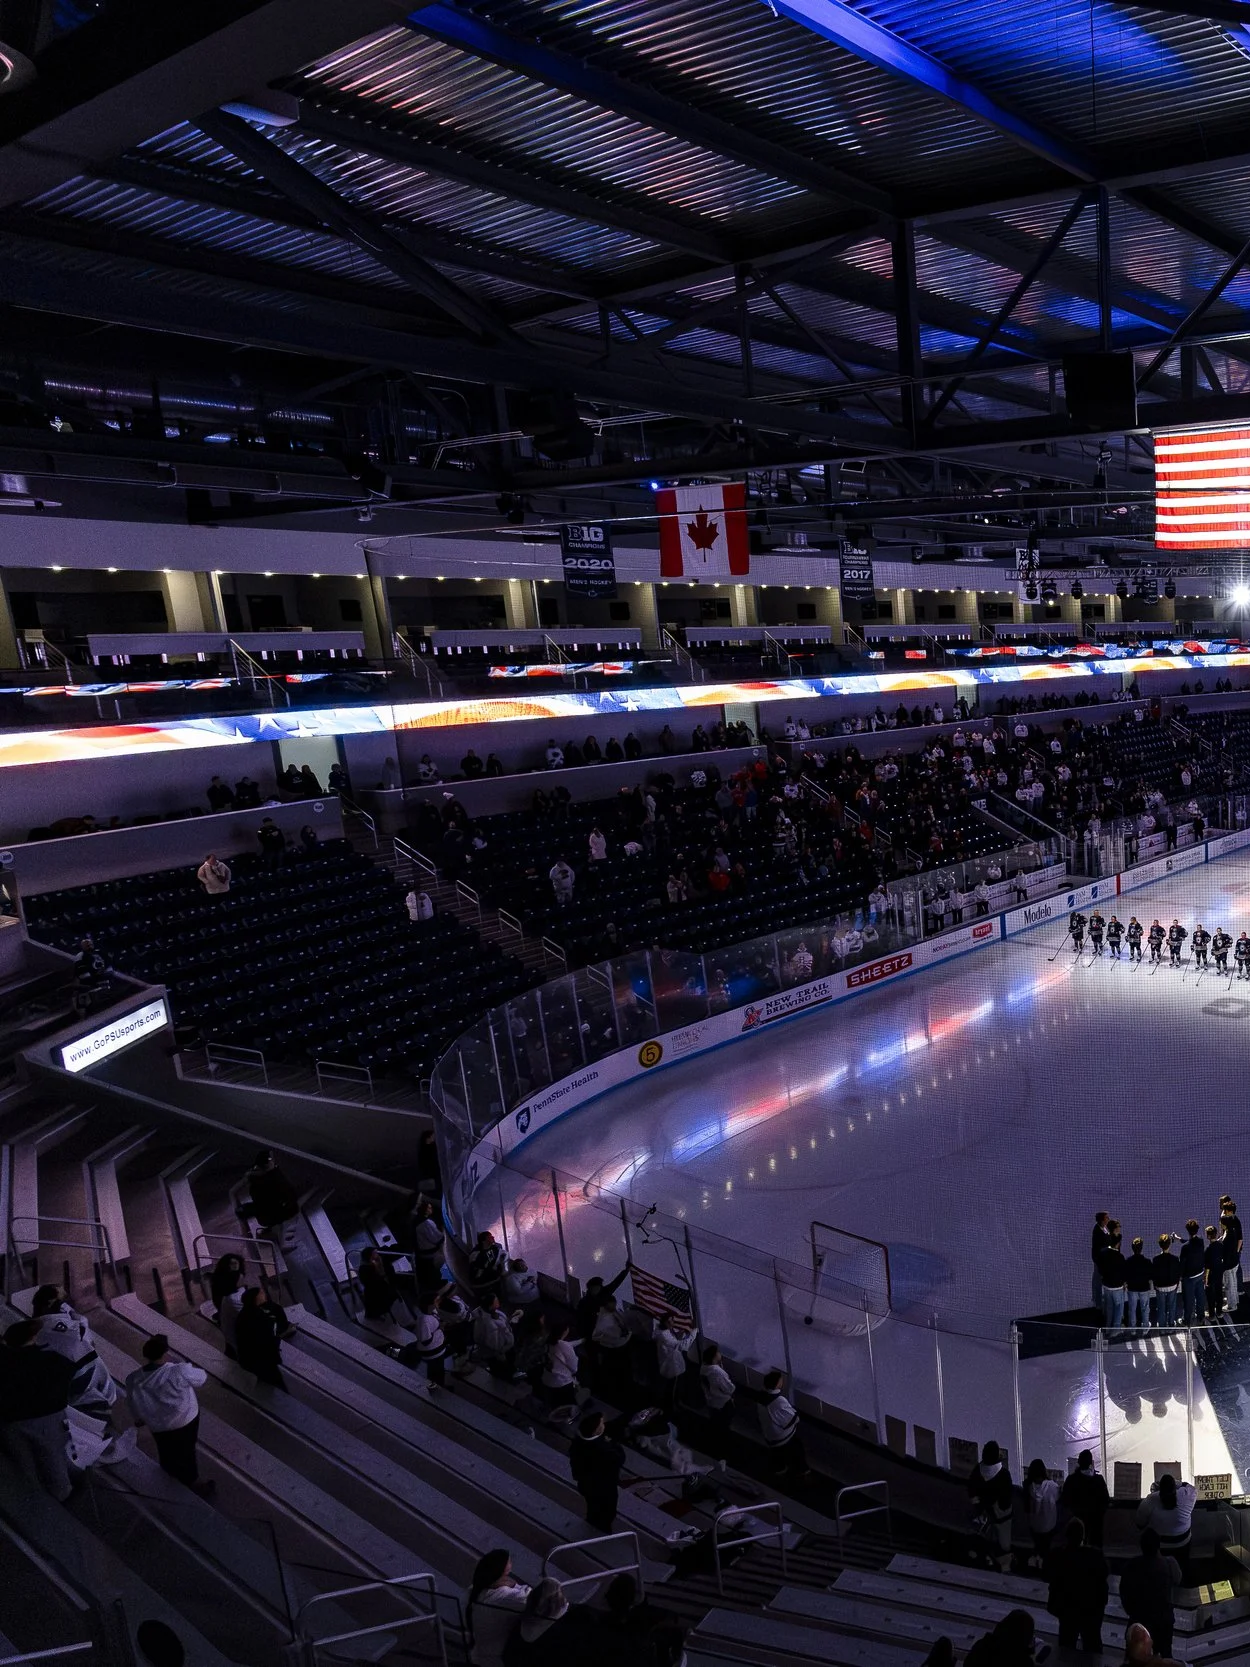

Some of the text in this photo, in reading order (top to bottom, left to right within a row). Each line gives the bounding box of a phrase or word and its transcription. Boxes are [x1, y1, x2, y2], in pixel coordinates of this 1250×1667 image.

[565, 558, 613, 570] 2020
[843, 569, 871, 579] 2017
[1024, 903, 1052, 925] Modelo
[974, 923, 992, 937] bryant
[850, 955, 910, 985] SHEETZ
[765, 982, 829, 1009] NEW TRAIL
[765, 989, 830, 1016] BREWING CO.
[69, 1009, 161, 1063] www.GoPSUsports.com
[646, 1047, 655, 1061] 5
[571, 1071, 599, 1091] Health
